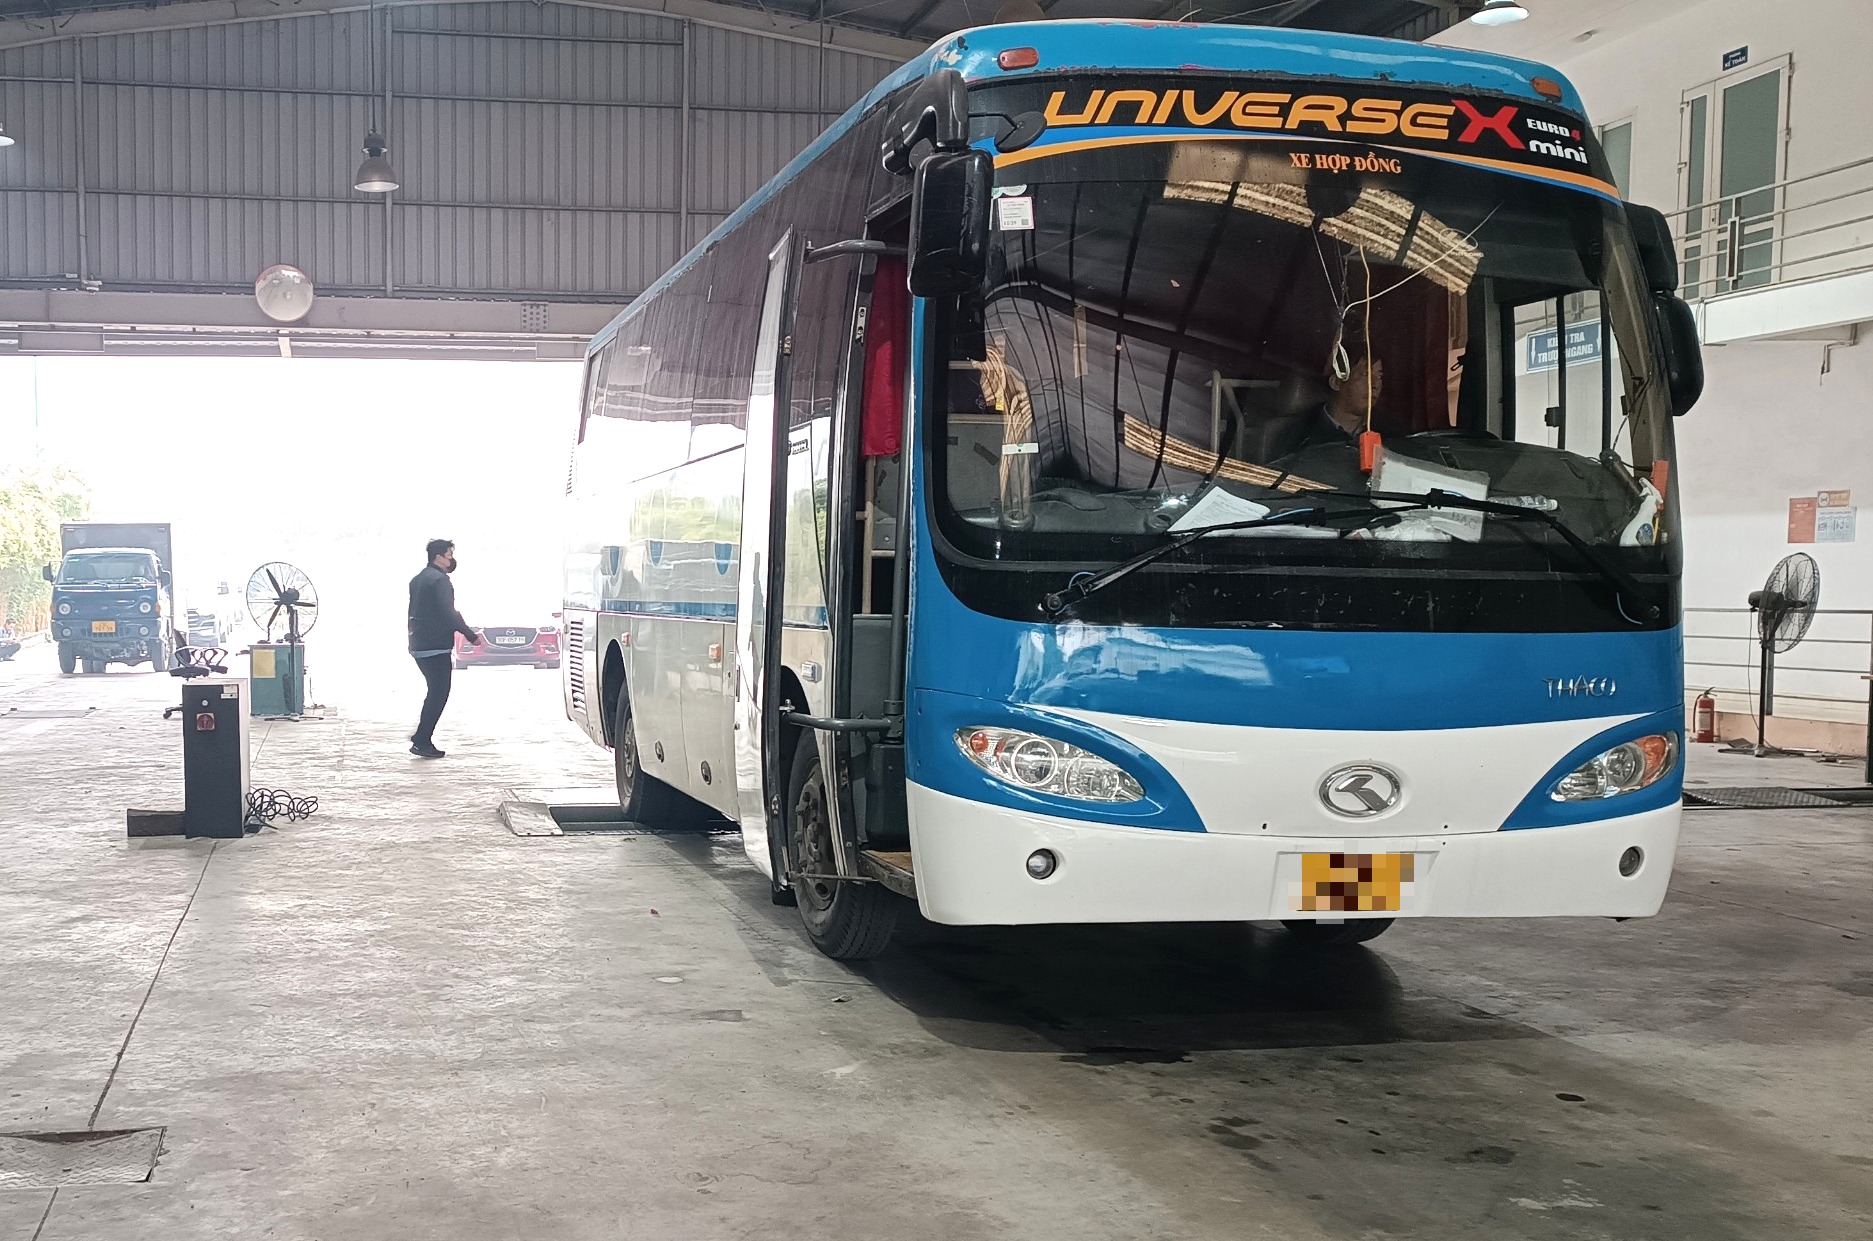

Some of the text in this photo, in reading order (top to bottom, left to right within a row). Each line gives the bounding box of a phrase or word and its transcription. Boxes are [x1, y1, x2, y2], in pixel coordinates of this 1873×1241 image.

[1289, 151, 1402, 174] XE HỢP ĐỒNG
[1529, 139, 1588, 164] mini
[1547, 332, 1585, 348] KI TRA
[1565, 344, 1594, 358] NGANG
[1542, 674, 1617, 699] THACO
